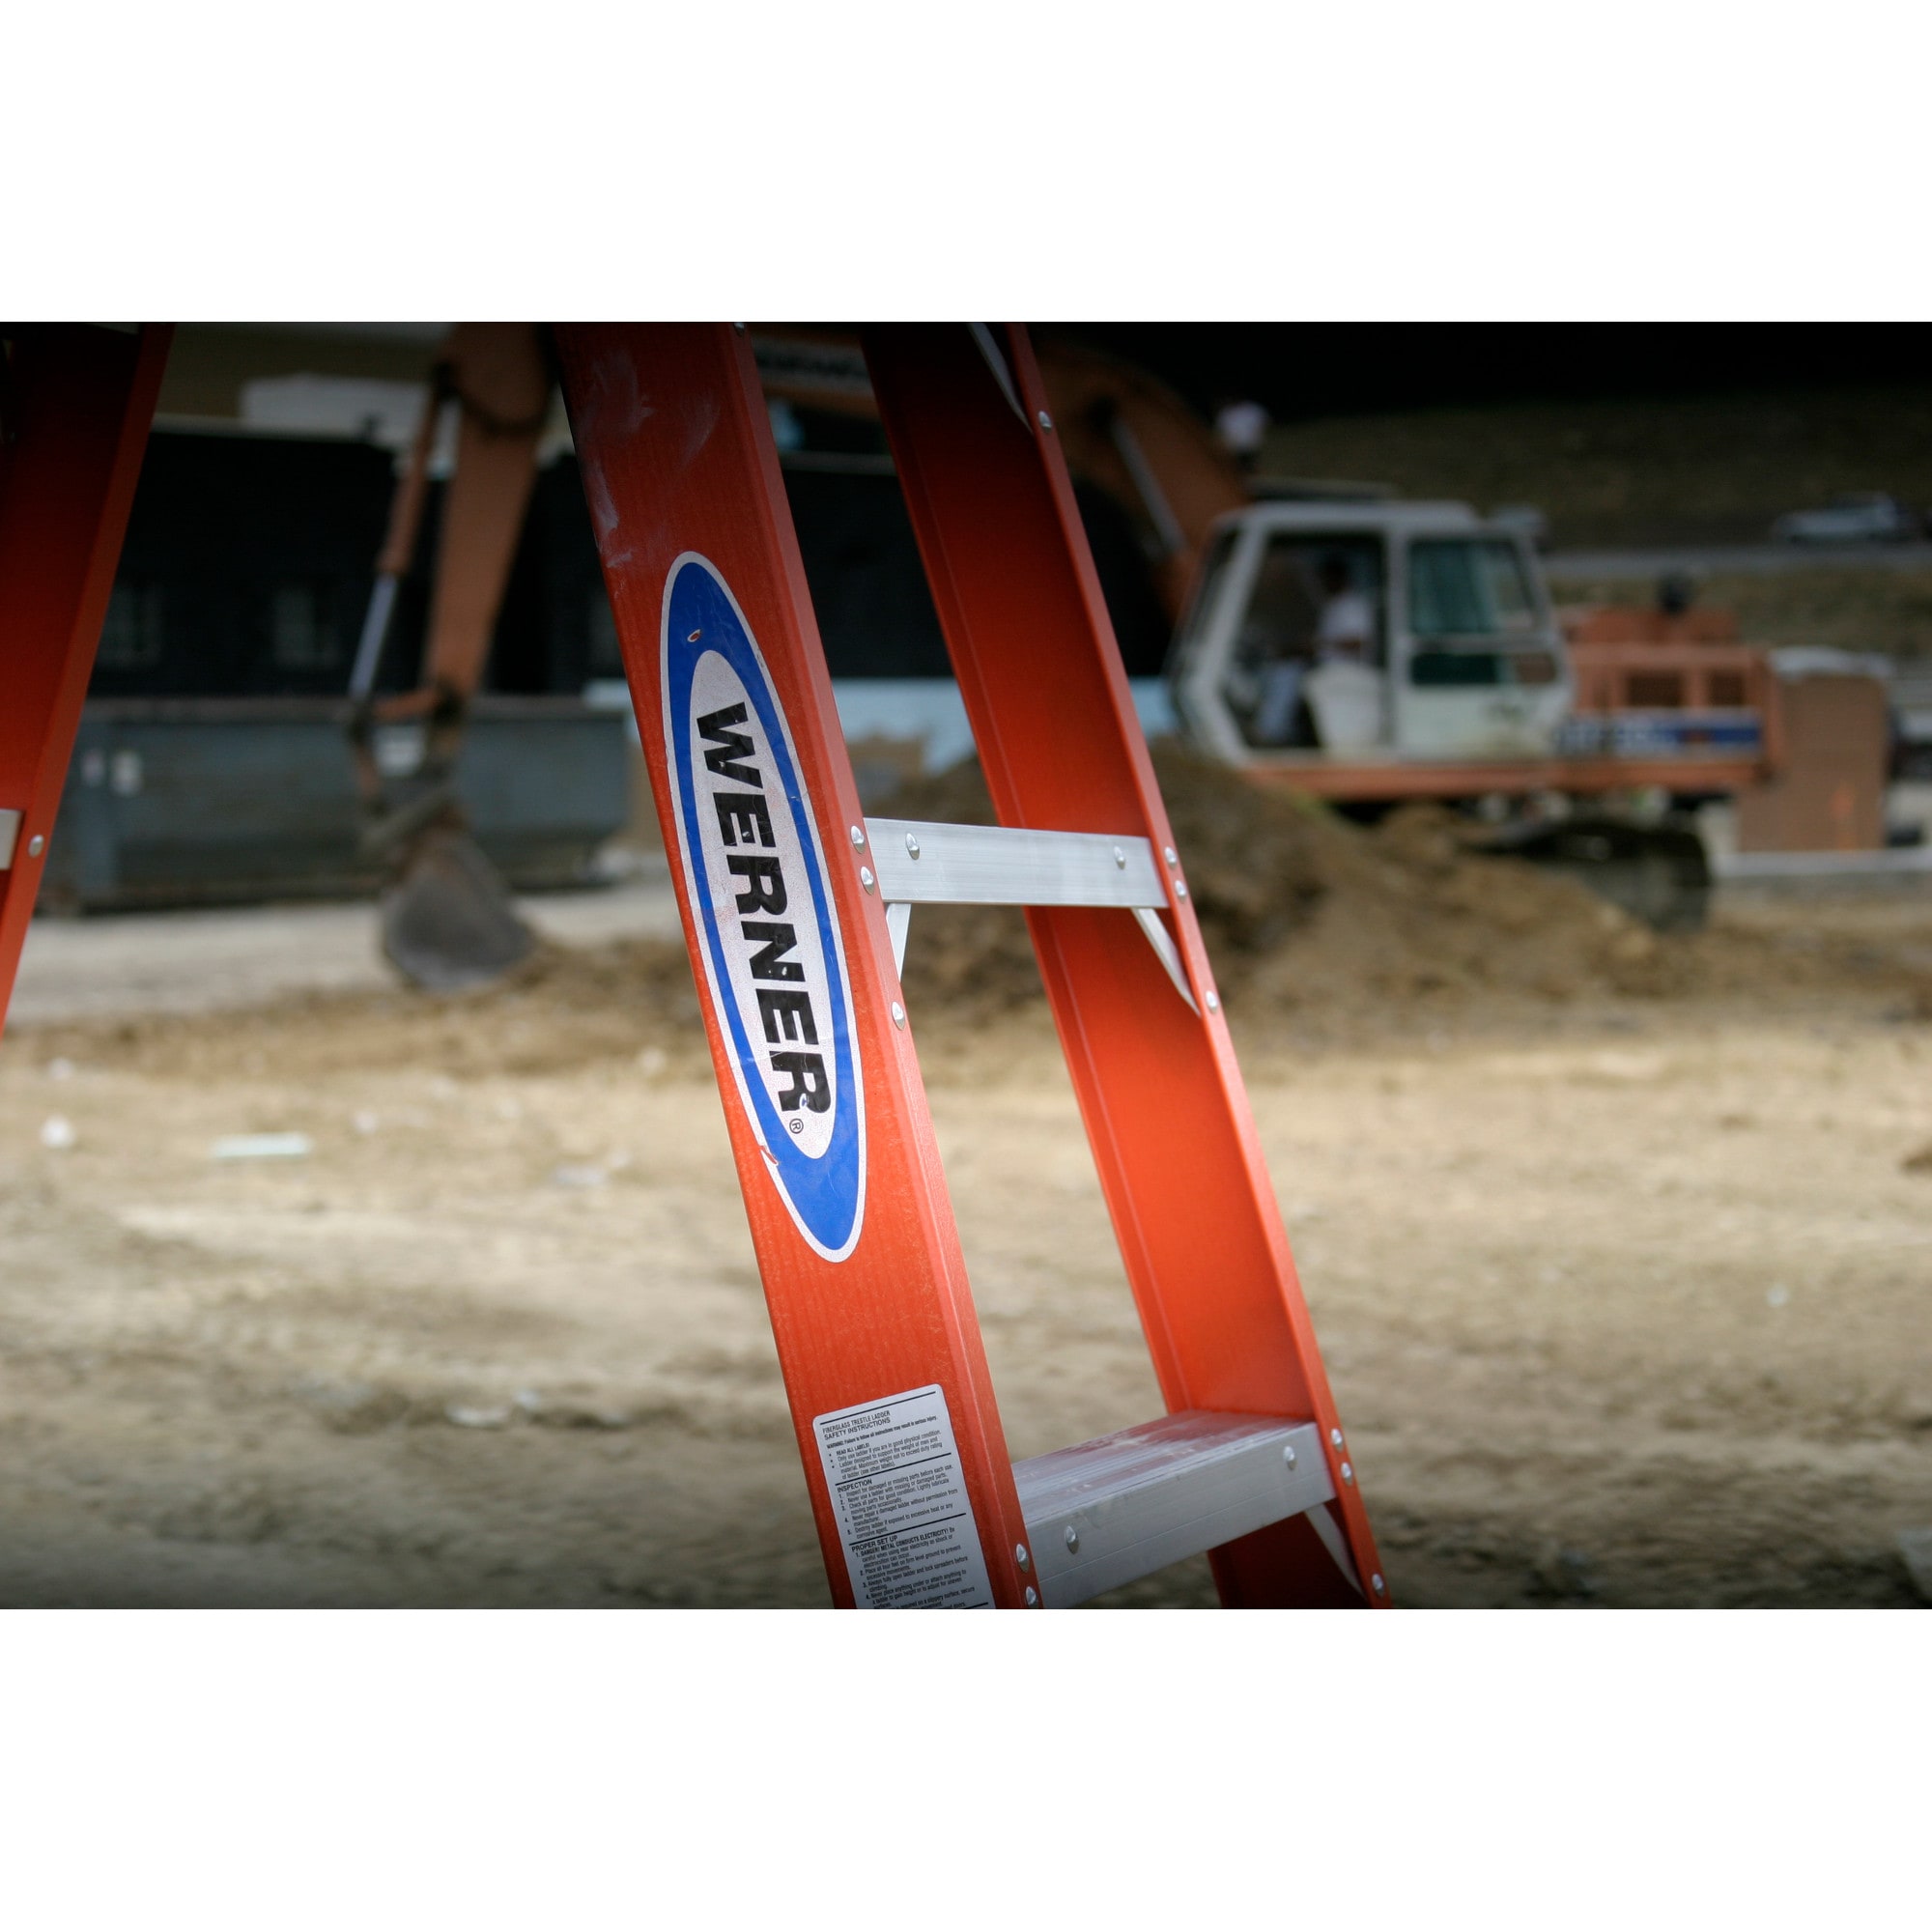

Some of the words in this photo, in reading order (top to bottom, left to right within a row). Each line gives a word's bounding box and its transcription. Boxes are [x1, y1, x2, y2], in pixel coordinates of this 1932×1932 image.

[696, 701, 831, 1113] WERNER
[824, 1430, 846, 1440] SAFETY
[847, 1417, 891, 1434] INSTRUCTIONS
[837, 1479, 872, 1492] INSPECTION
[851, 1541, 876, 1552] PROPER
